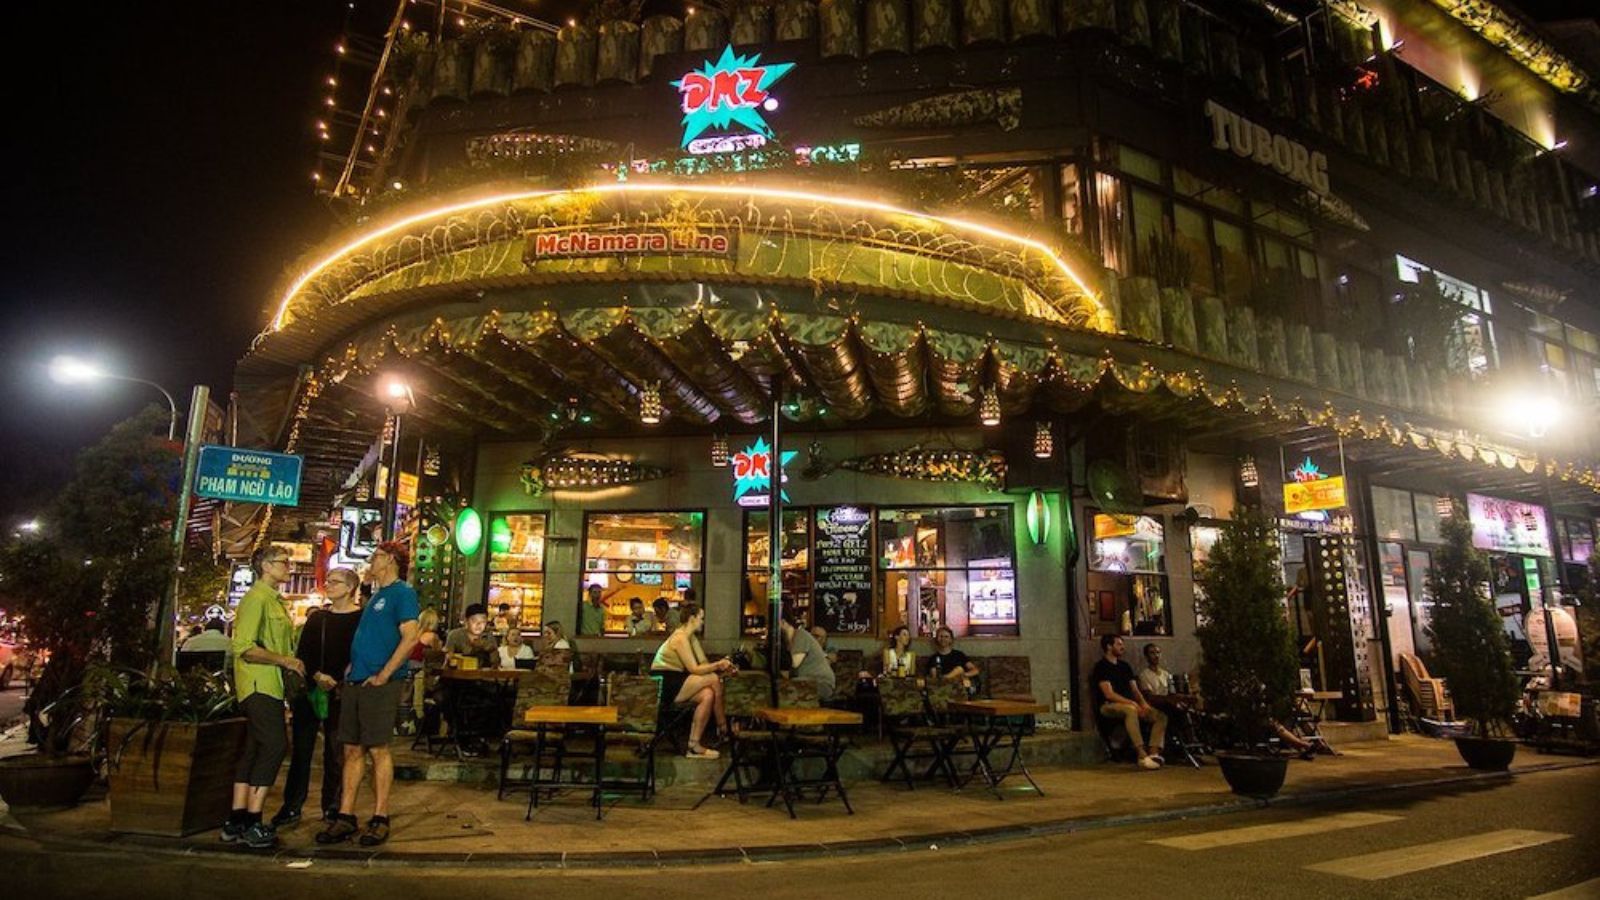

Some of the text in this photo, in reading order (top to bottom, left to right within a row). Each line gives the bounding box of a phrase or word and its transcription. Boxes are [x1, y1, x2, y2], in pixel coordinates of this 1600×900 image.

[680, 67, 768, 113] DMZ
[1204, 99, 1330, 196] TUBORG
[534, 232, 668, 255] McNamara
[732, 452, 771, 480] DM
[200, 477, 237, 496] PHẠM
[269, 481, 293, 498] LÃO
